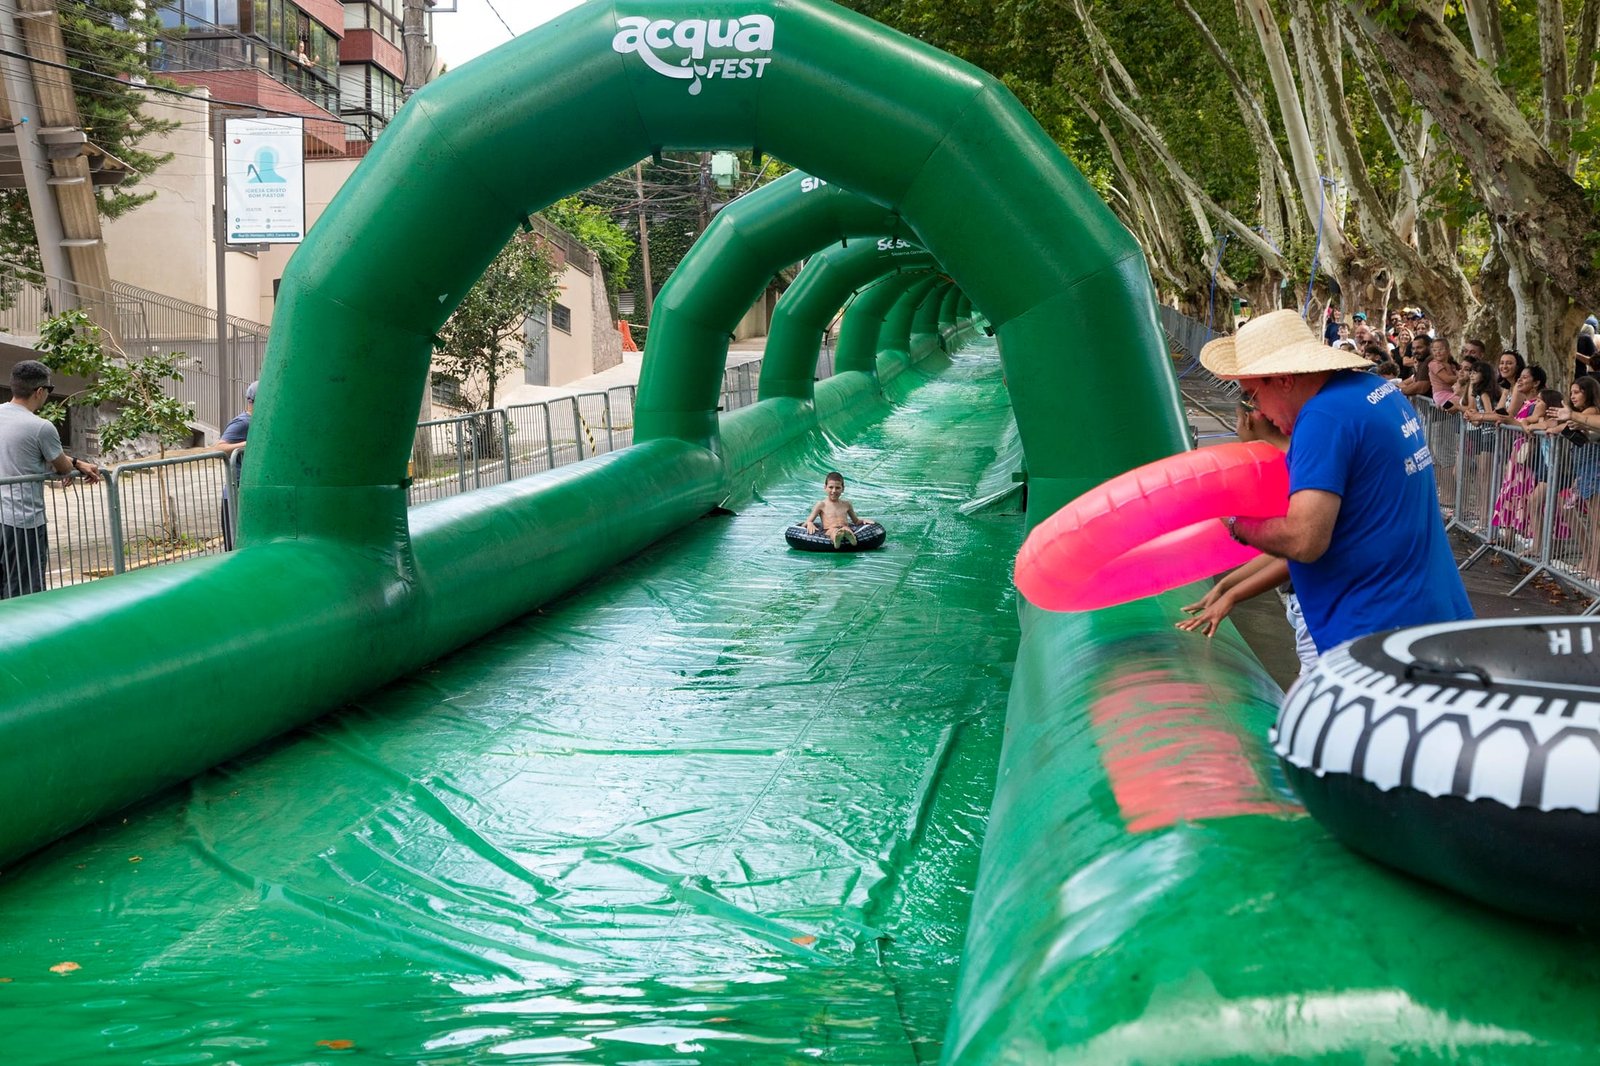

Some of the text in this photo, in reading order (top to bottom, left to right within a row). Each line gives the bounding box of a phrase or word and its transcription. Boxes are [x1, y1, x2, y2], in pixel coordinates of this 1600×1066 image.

[612, 14, 775, 60] acqua
[706, 58, 772, 79] FEST
[1547, 626, 1600, 656] HI
